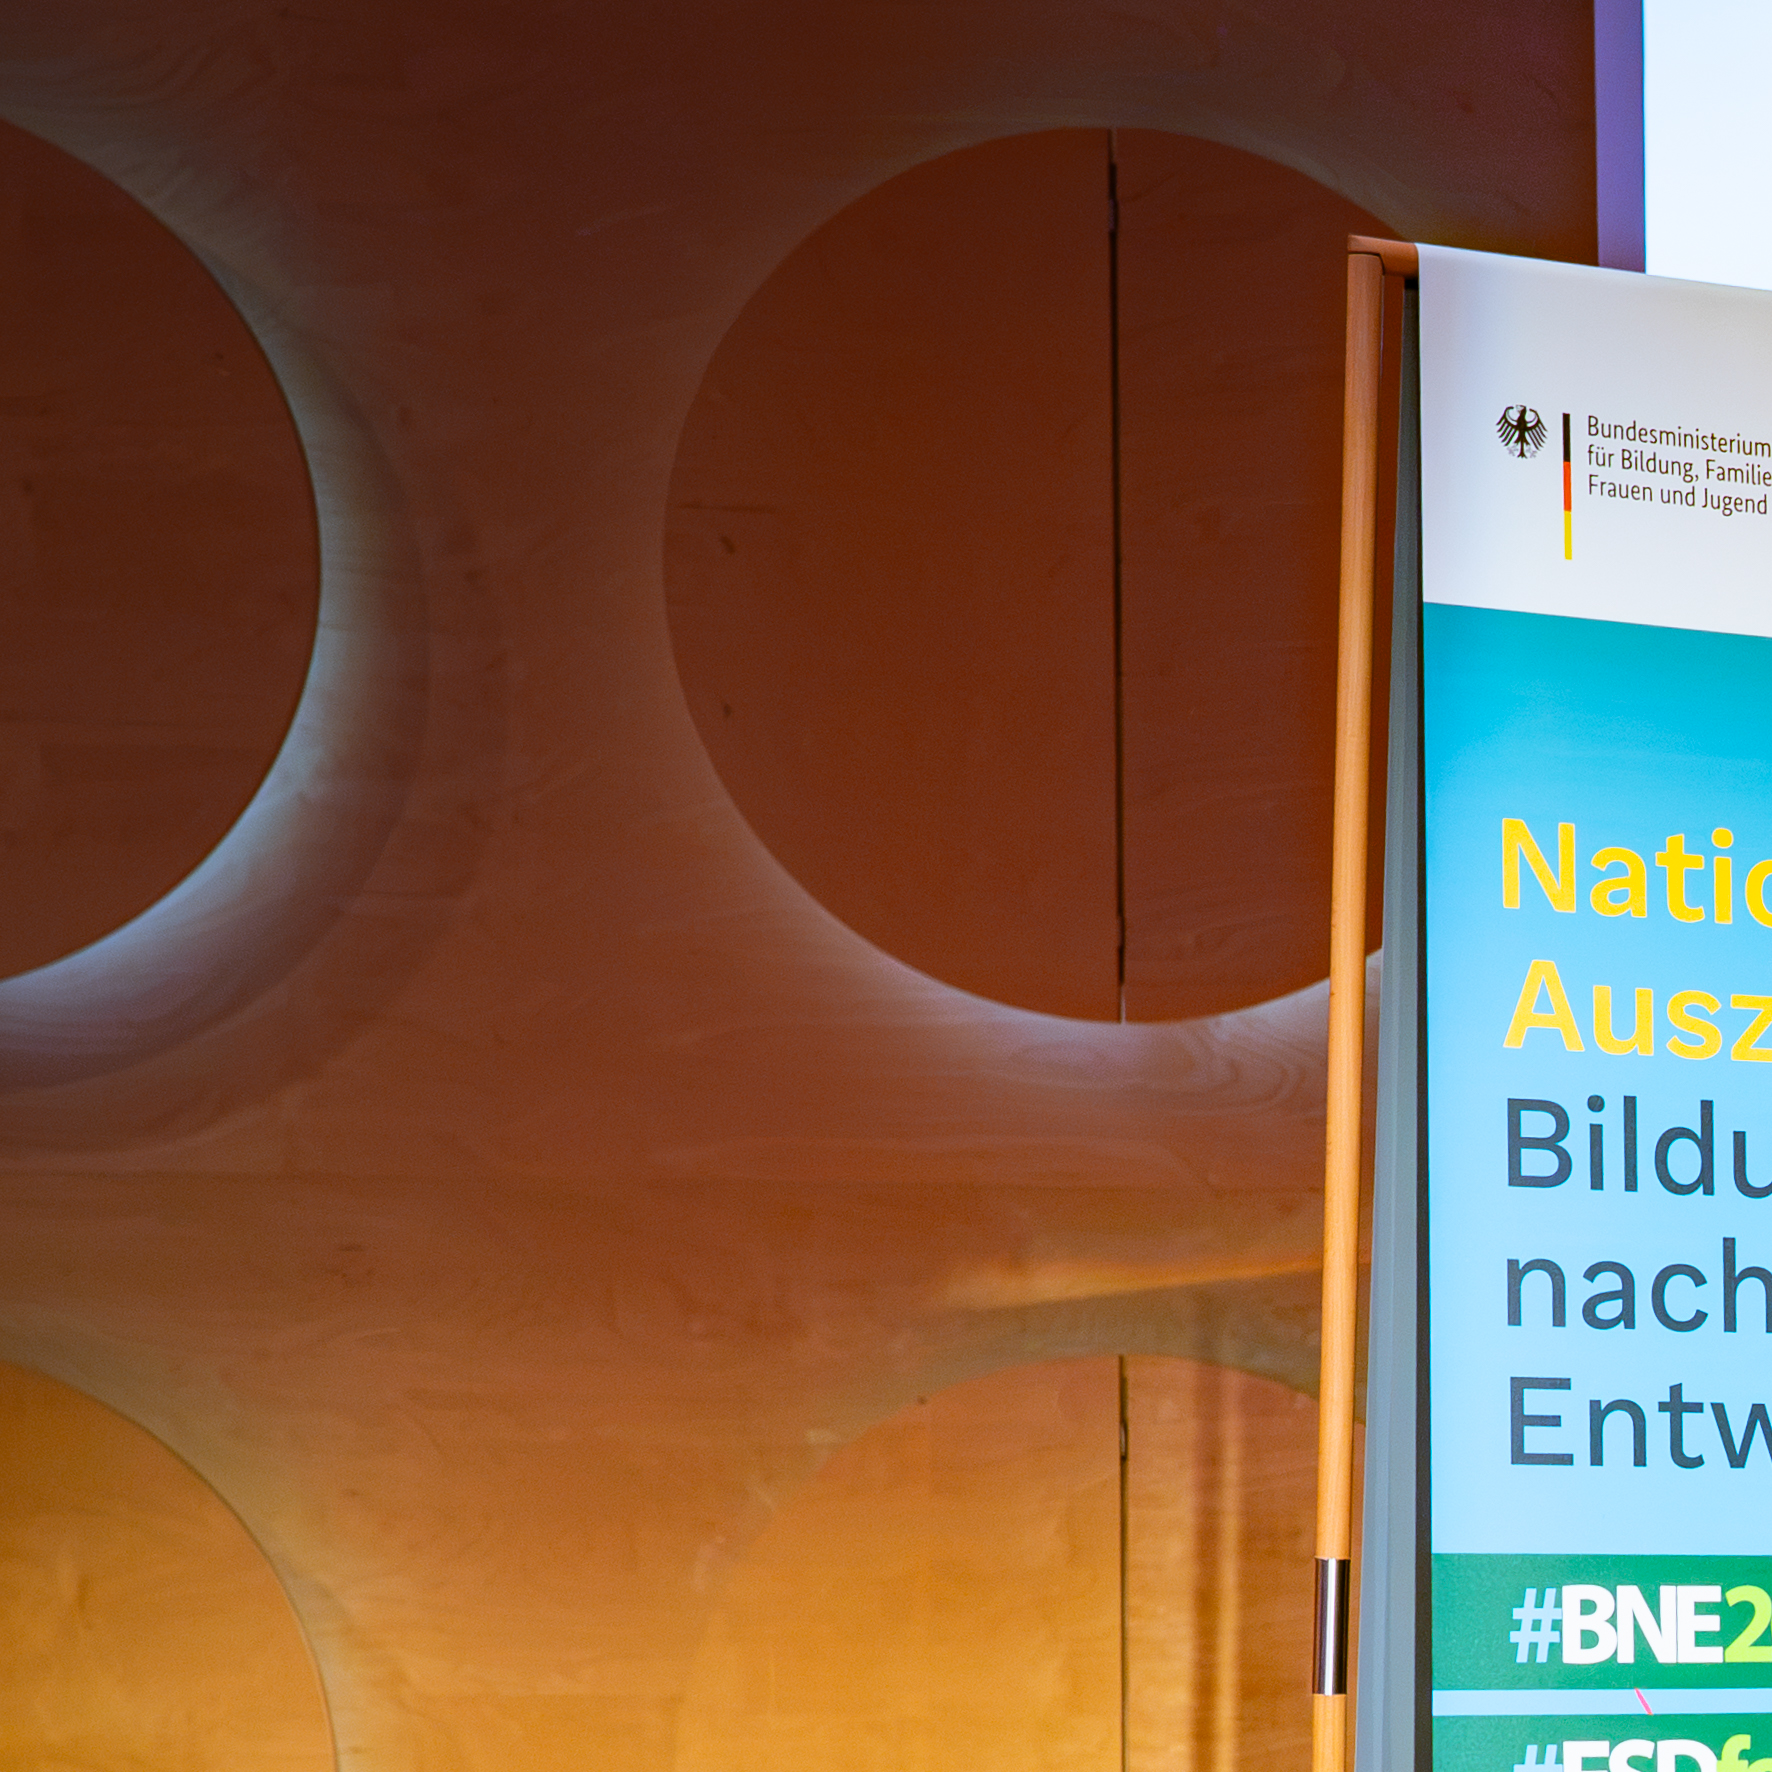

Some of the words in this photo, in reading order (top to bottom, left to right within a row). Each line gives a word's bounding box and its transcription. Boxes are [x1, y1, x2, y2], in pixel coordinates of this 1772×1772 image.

[1587, 415, 1772, 458] Bundesministerium
[1588, 445, 1615, 467] für
[1621, 448, 1699, 484] Bildung,
[1588, 475, 1653, 502] Frauen
[1660, 483, 1696, 507] und
[1702, 486, 1768, 517] Jugend
